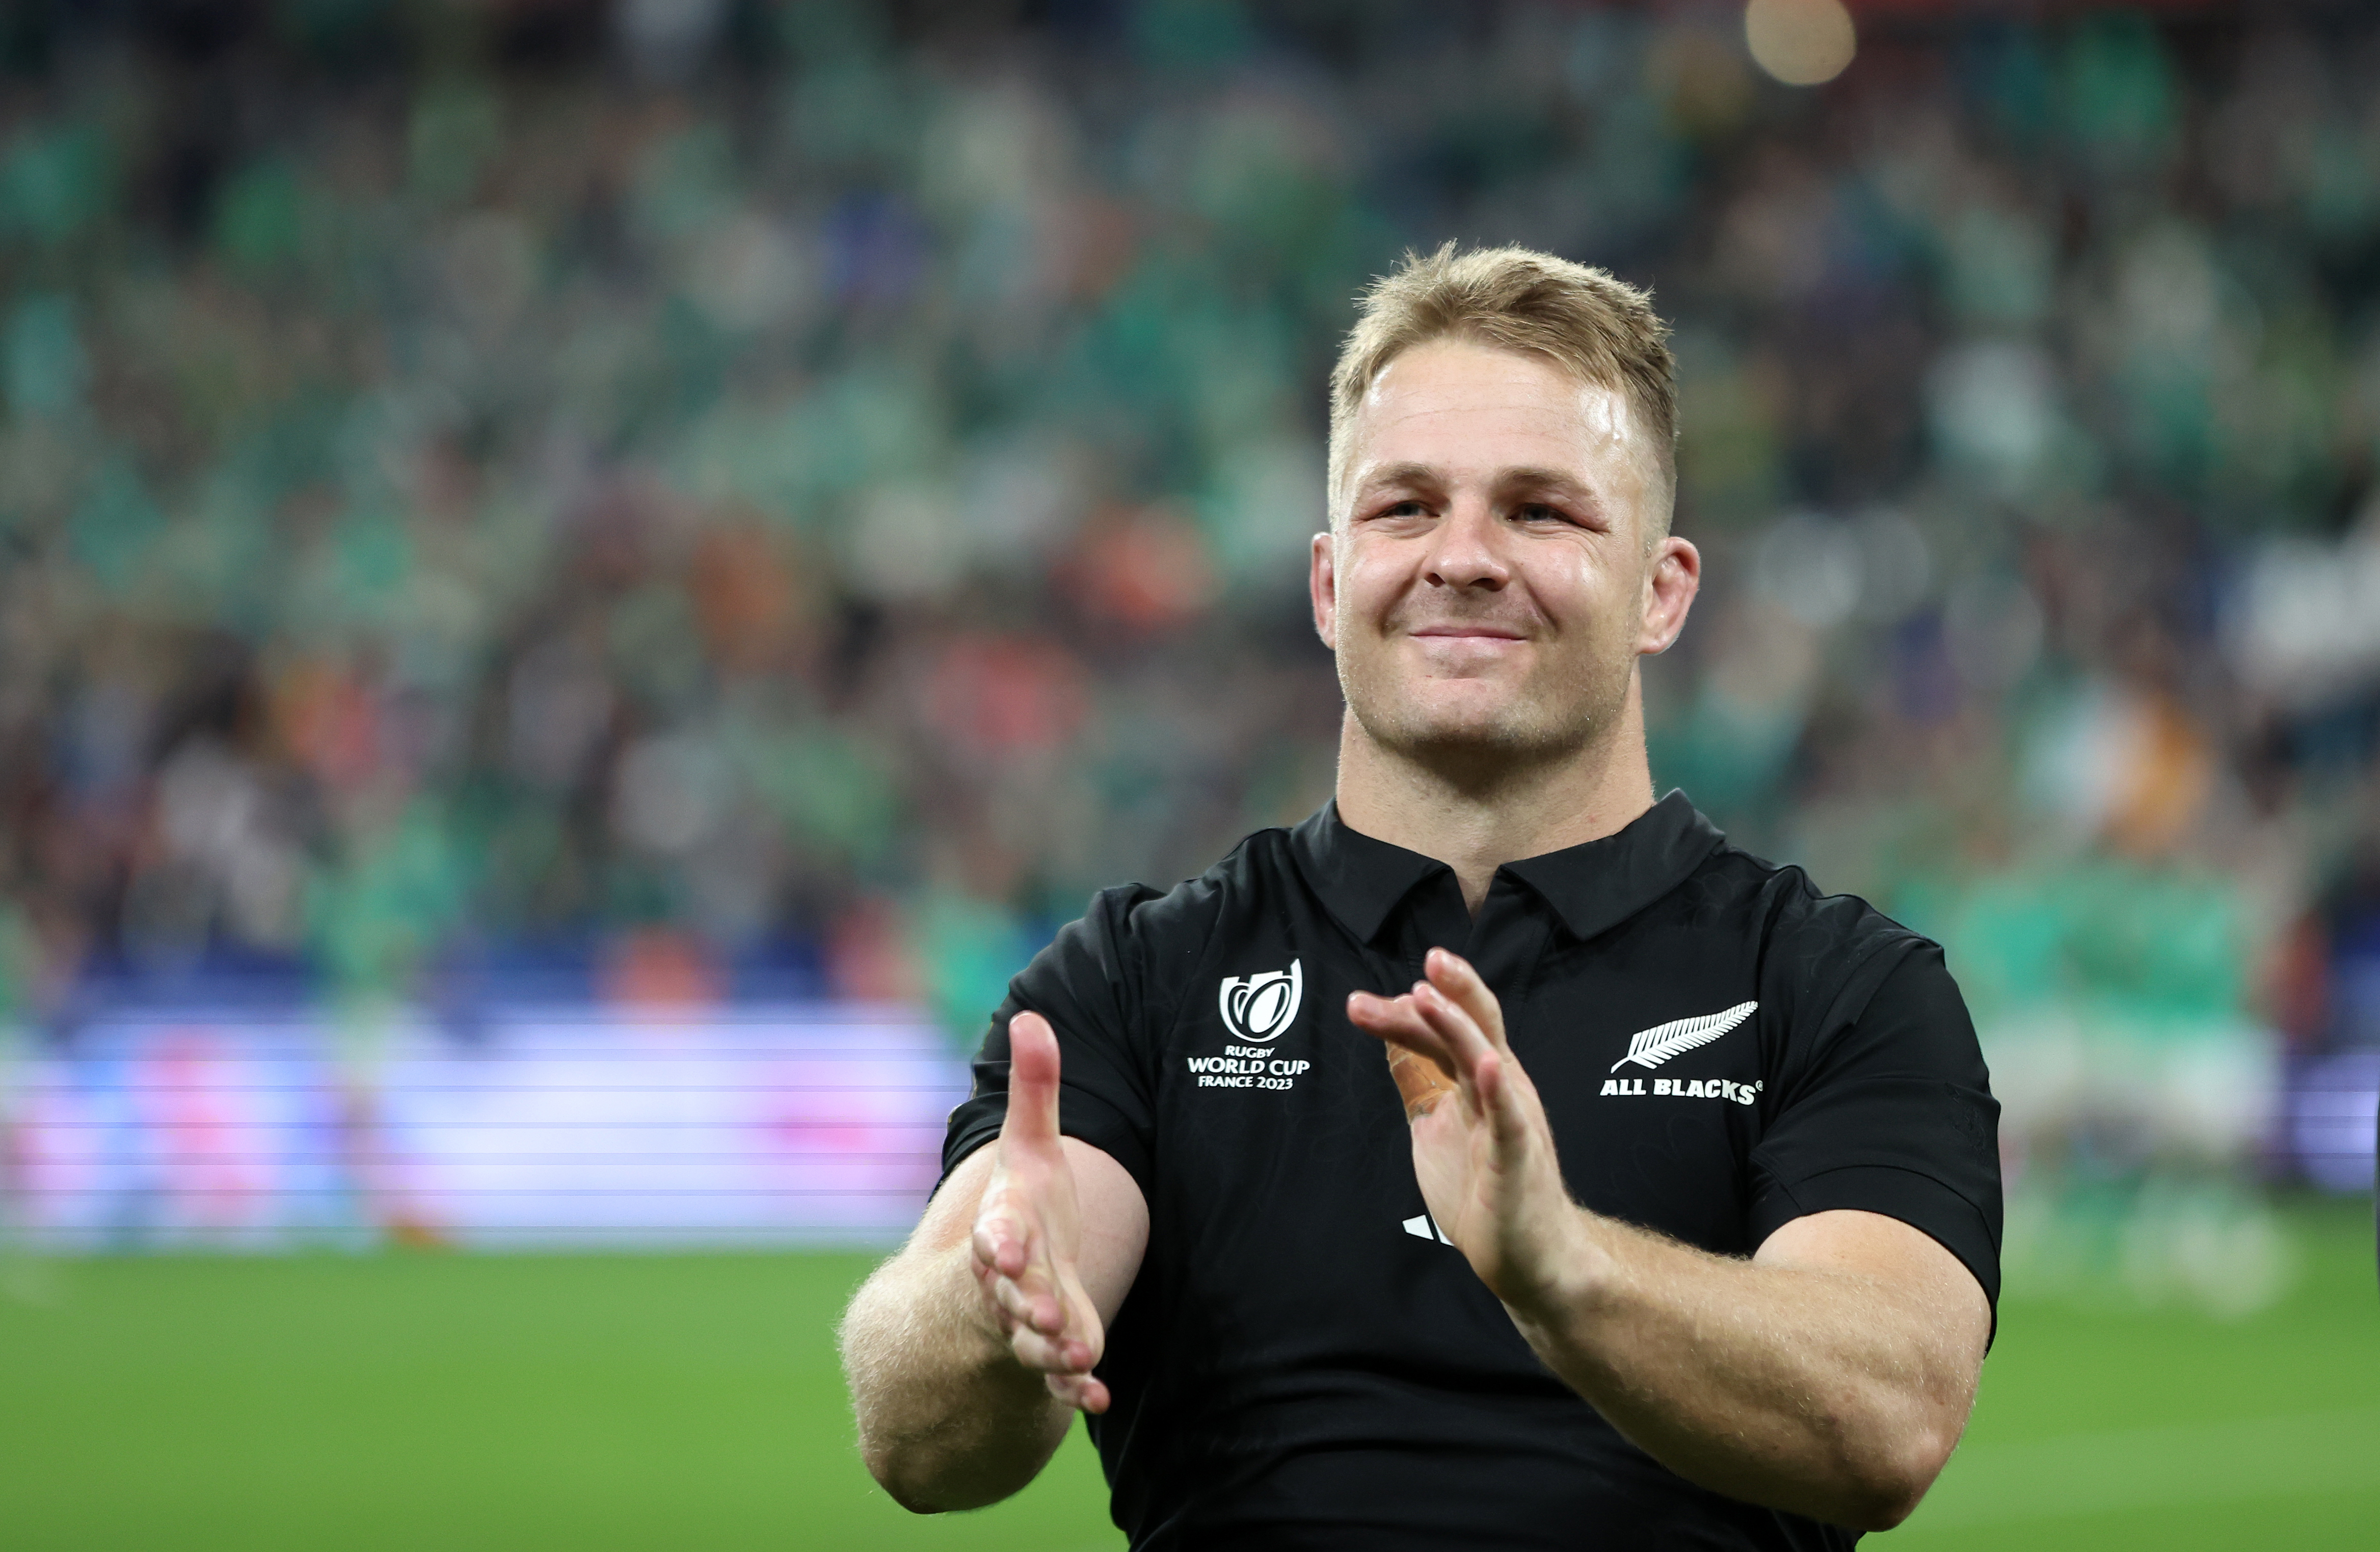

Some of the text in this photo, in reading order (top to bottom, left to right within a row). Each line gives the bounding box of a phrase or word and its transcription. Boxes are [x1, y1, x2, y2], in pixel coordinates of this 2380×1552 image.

[1224, 1045, 1275, 1059] RUGBY
[1187, 1057, 1311, 1076] WORLD CUP
[1197, 1075, 1293, 1090] FRANCE 2023
[1599, 1078, 1647, 1096] ALL
